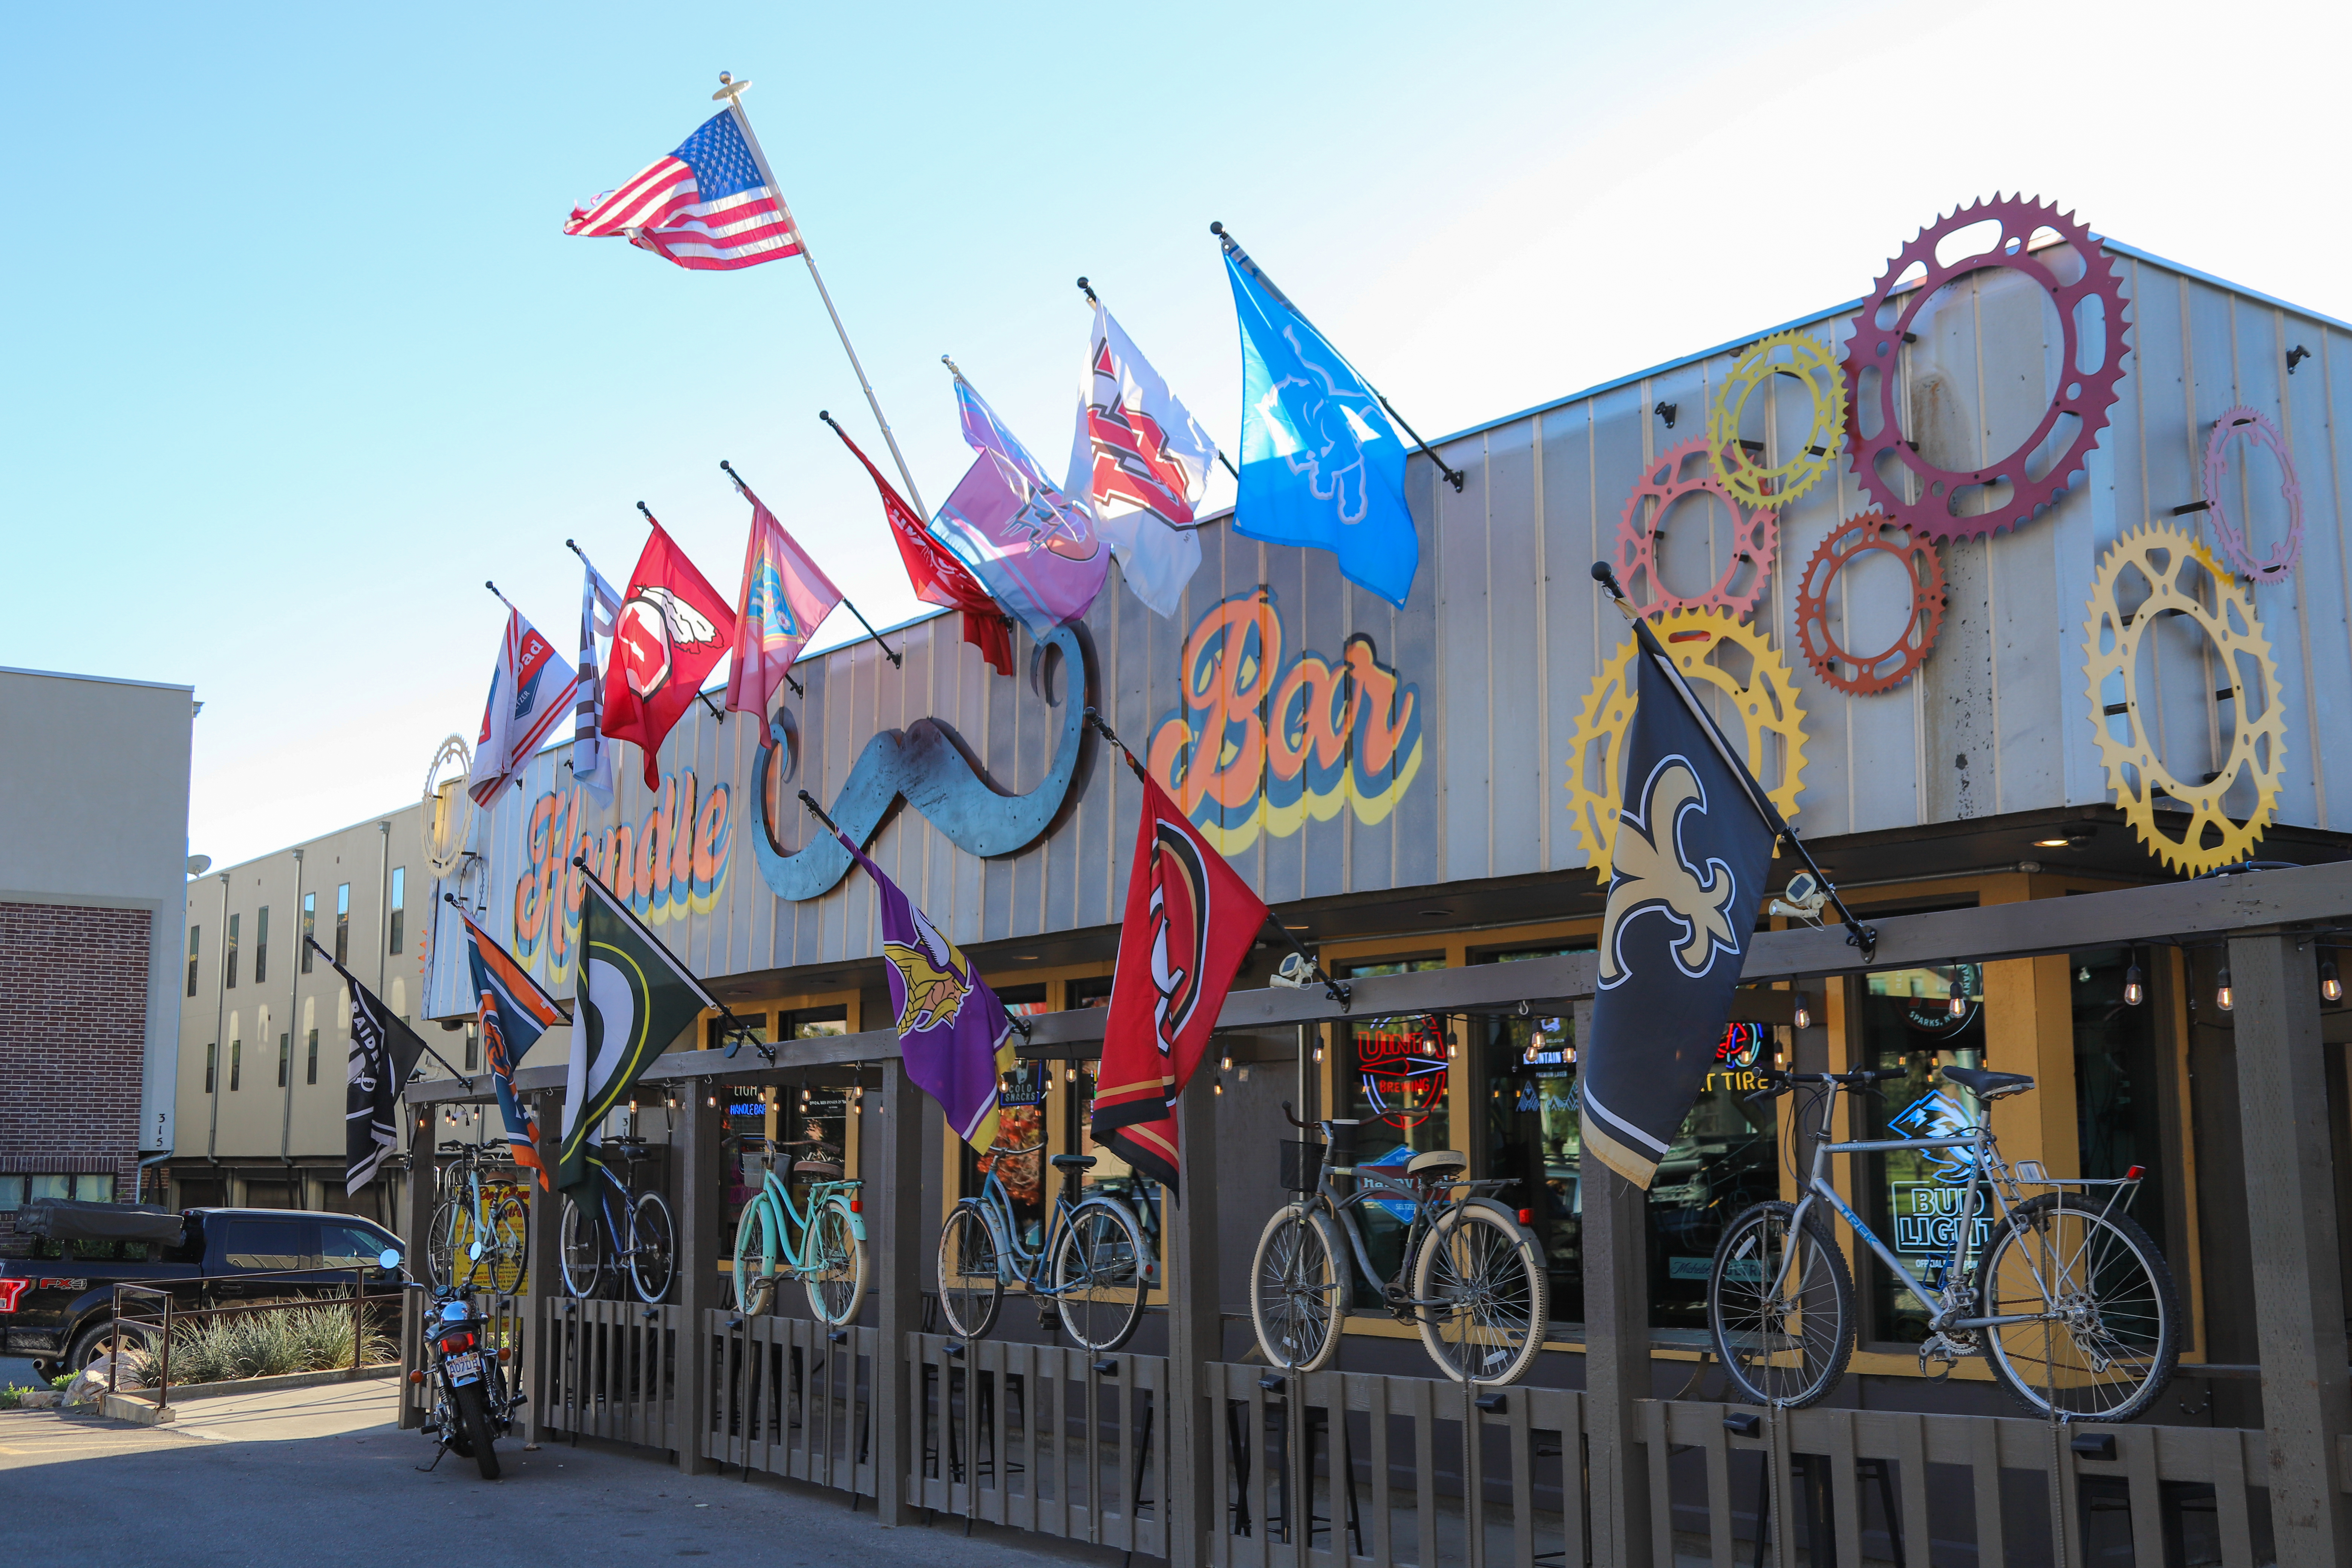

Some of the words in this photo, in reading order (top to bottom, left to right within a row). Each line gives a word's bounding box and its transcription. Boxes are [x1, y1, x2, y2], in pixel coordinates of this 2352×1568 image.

[1146, 585, 1421, 846] Bar
[513, 767, 732, 971] Handle
[1005, 1092, 1035, 1102] SNACKS
[1009, 1084, 1032, 1093] COLD
[1380, 1077, 1430, 1093] BREWING
[156, 1113, 165, 1147] 315
[1911, 1188, 1985, 1217] BUD
[1841, 1204, 1879, 1249] TREK
[1899, 1217, 1994, 1246] LIGHT
[40, 1278, 87, 1289] FX4
